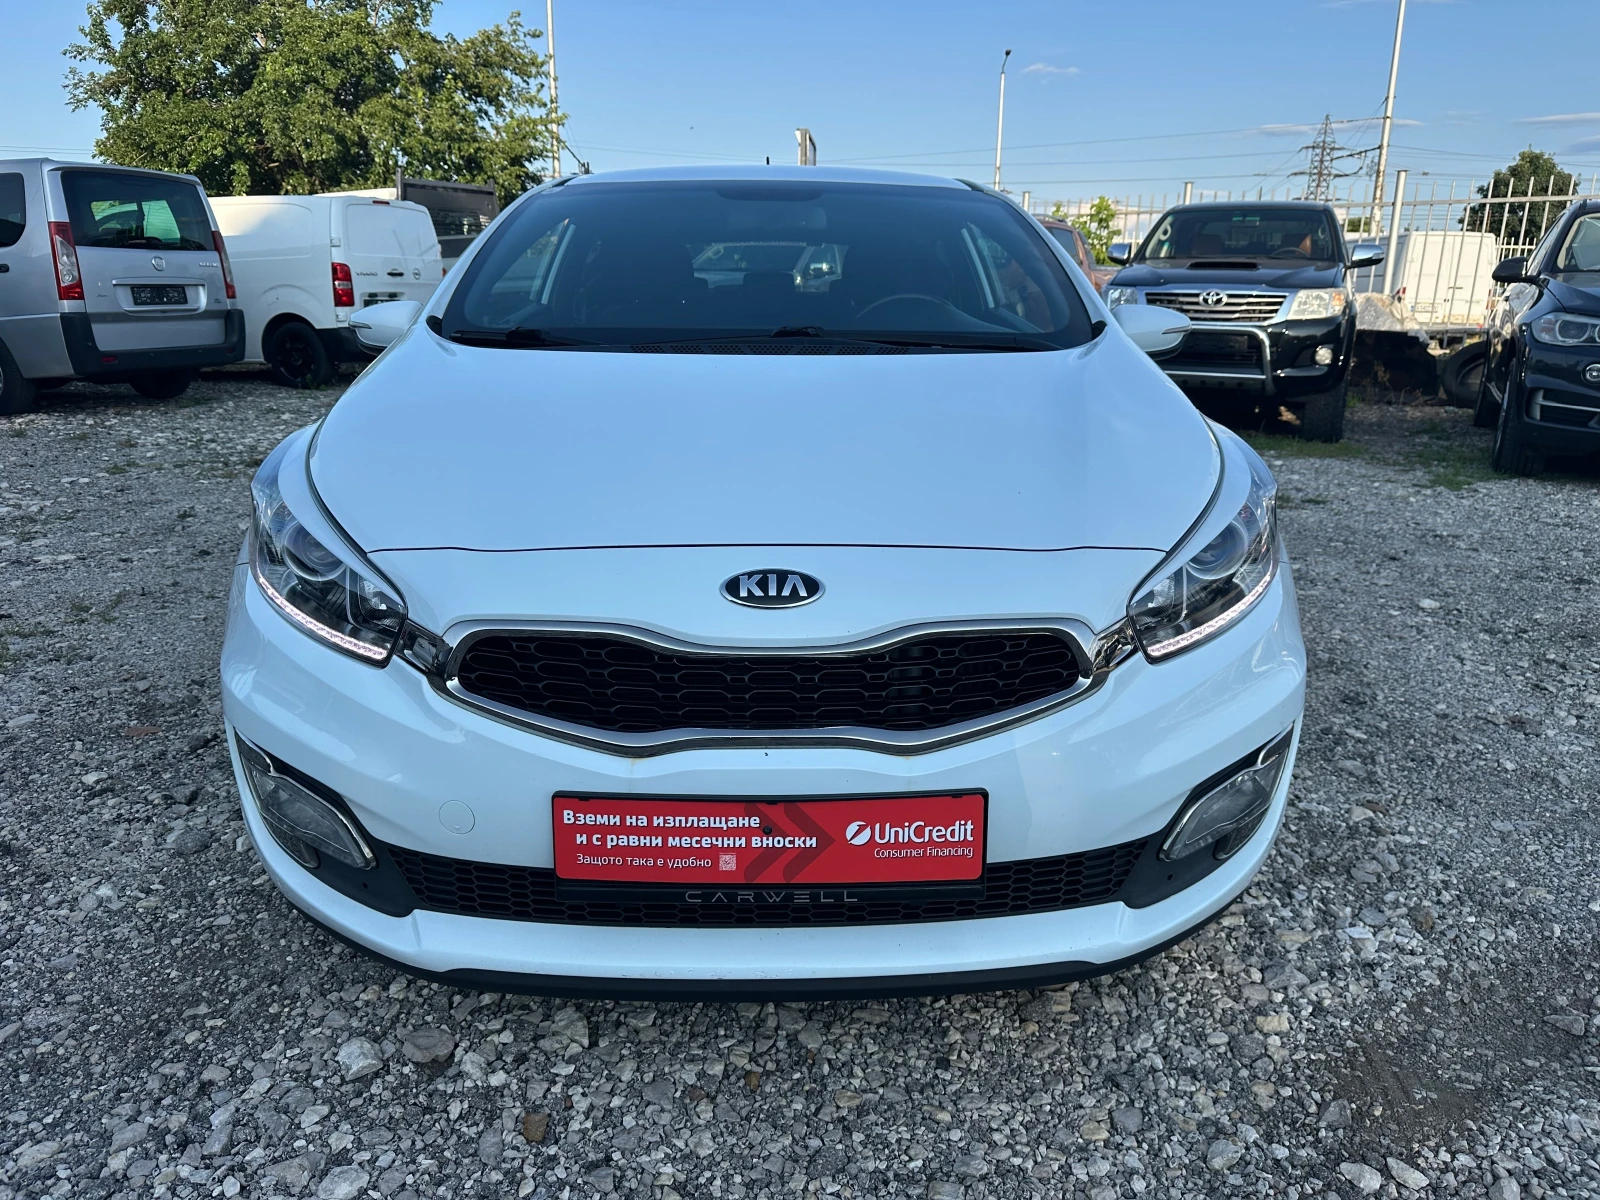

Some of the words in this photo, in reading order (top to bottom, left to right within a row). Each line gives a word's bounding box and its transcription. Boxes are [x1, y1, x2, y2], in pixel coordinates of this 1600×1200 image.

[738, 573, 808, 597] KIA
[563, 809, 621, 826] Вземи
[626, 815, 648, 827] на
[653, 816, 760, 830] изплащане
[874, 819, 974, 844] UniCredit
[576, 833, 588, 845] и
[592, 835, 602, 845] с
[606, 834, 663, 849] равни
[667, 836, 746, 848] месечни
[751, 836, 817, 848] вноски
[874, 848, 924, 858] Consumer
[926, 846, 973, 858] Financing
[576, 853, 623, 866] Защото
[626, 857, 654, 866] така
[657, 858, 664, 867] е
[667, 857, 712, 869] удобно
[685, 890, 858, 903] CARWELL
